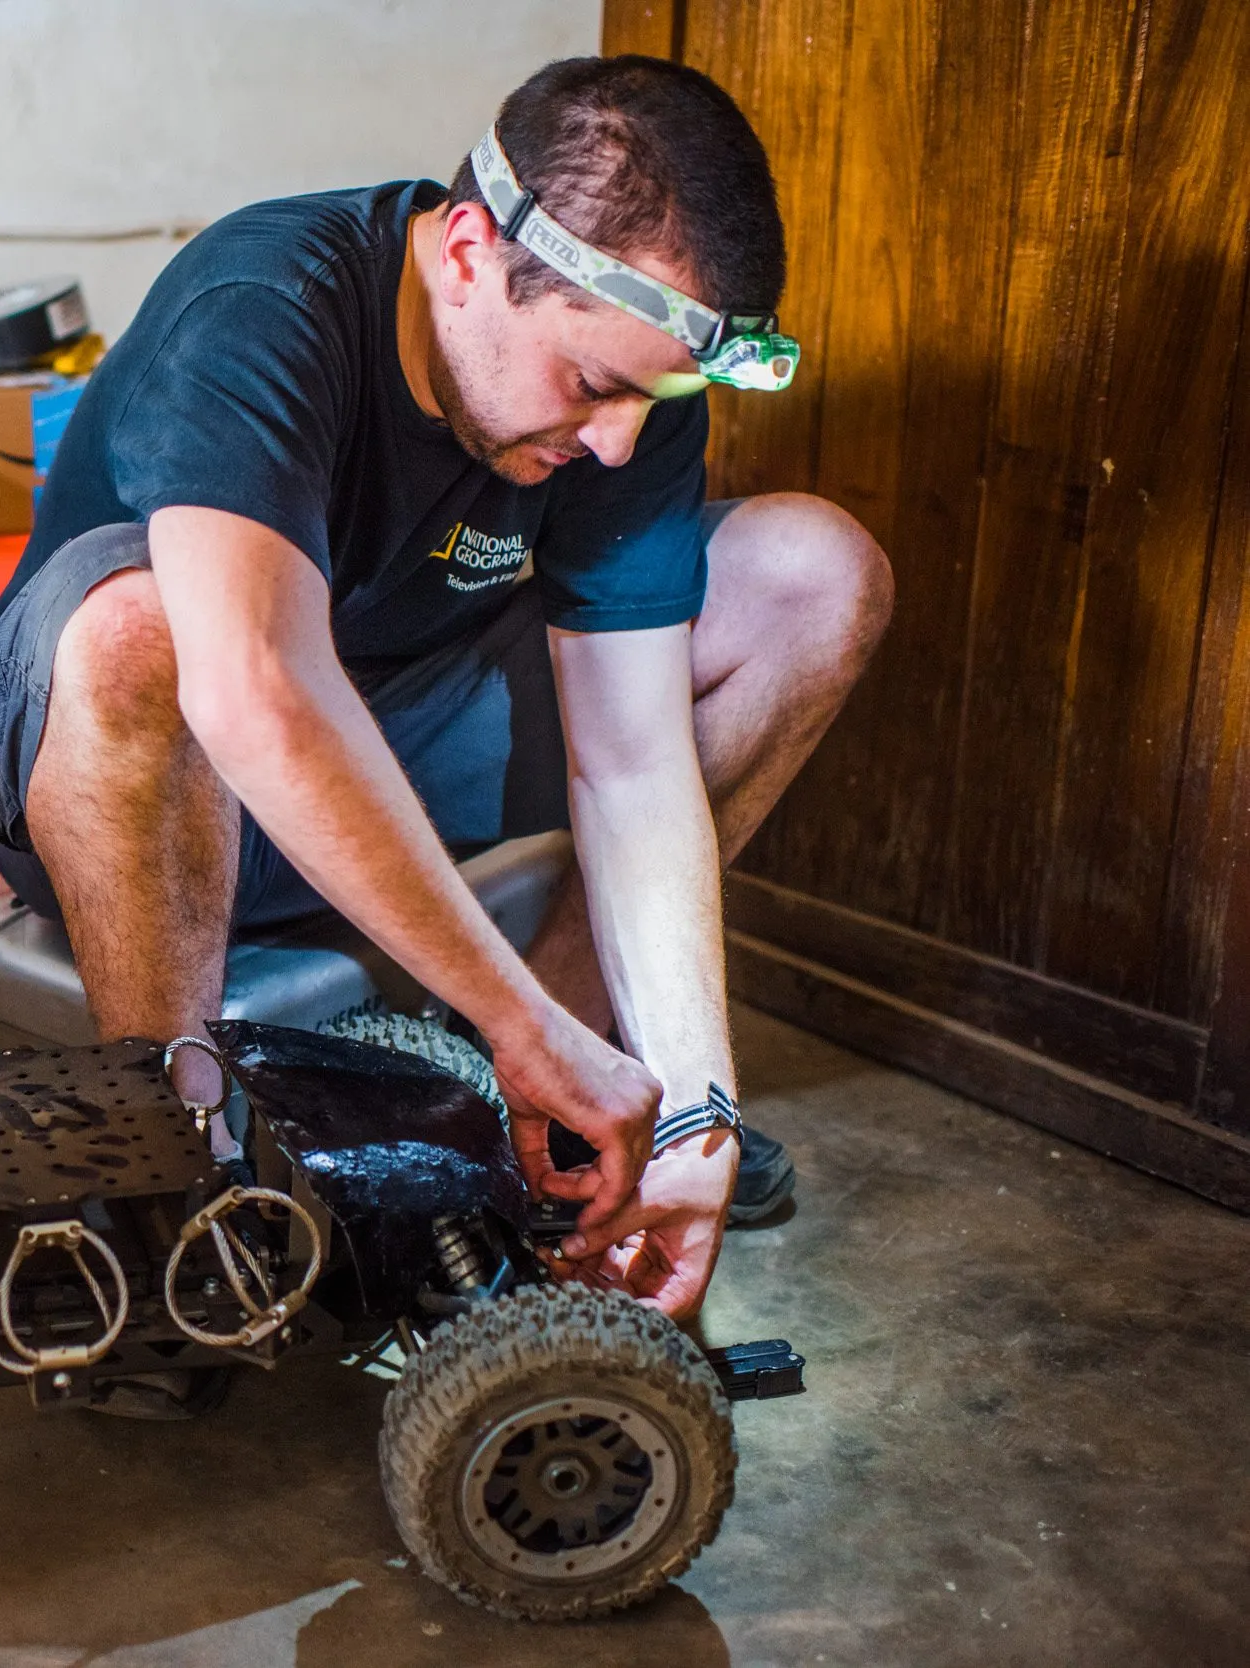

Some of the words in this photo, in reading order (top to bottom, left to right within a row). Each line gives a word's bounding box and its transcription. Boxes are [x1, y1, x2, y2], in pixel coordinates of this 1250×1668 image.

[527, 221, 578, 267] PETZL
[461, 525, 525, 553] NATIONAL
[447, 573, 490, 592] Television
[490, 575, 499, 585] &
